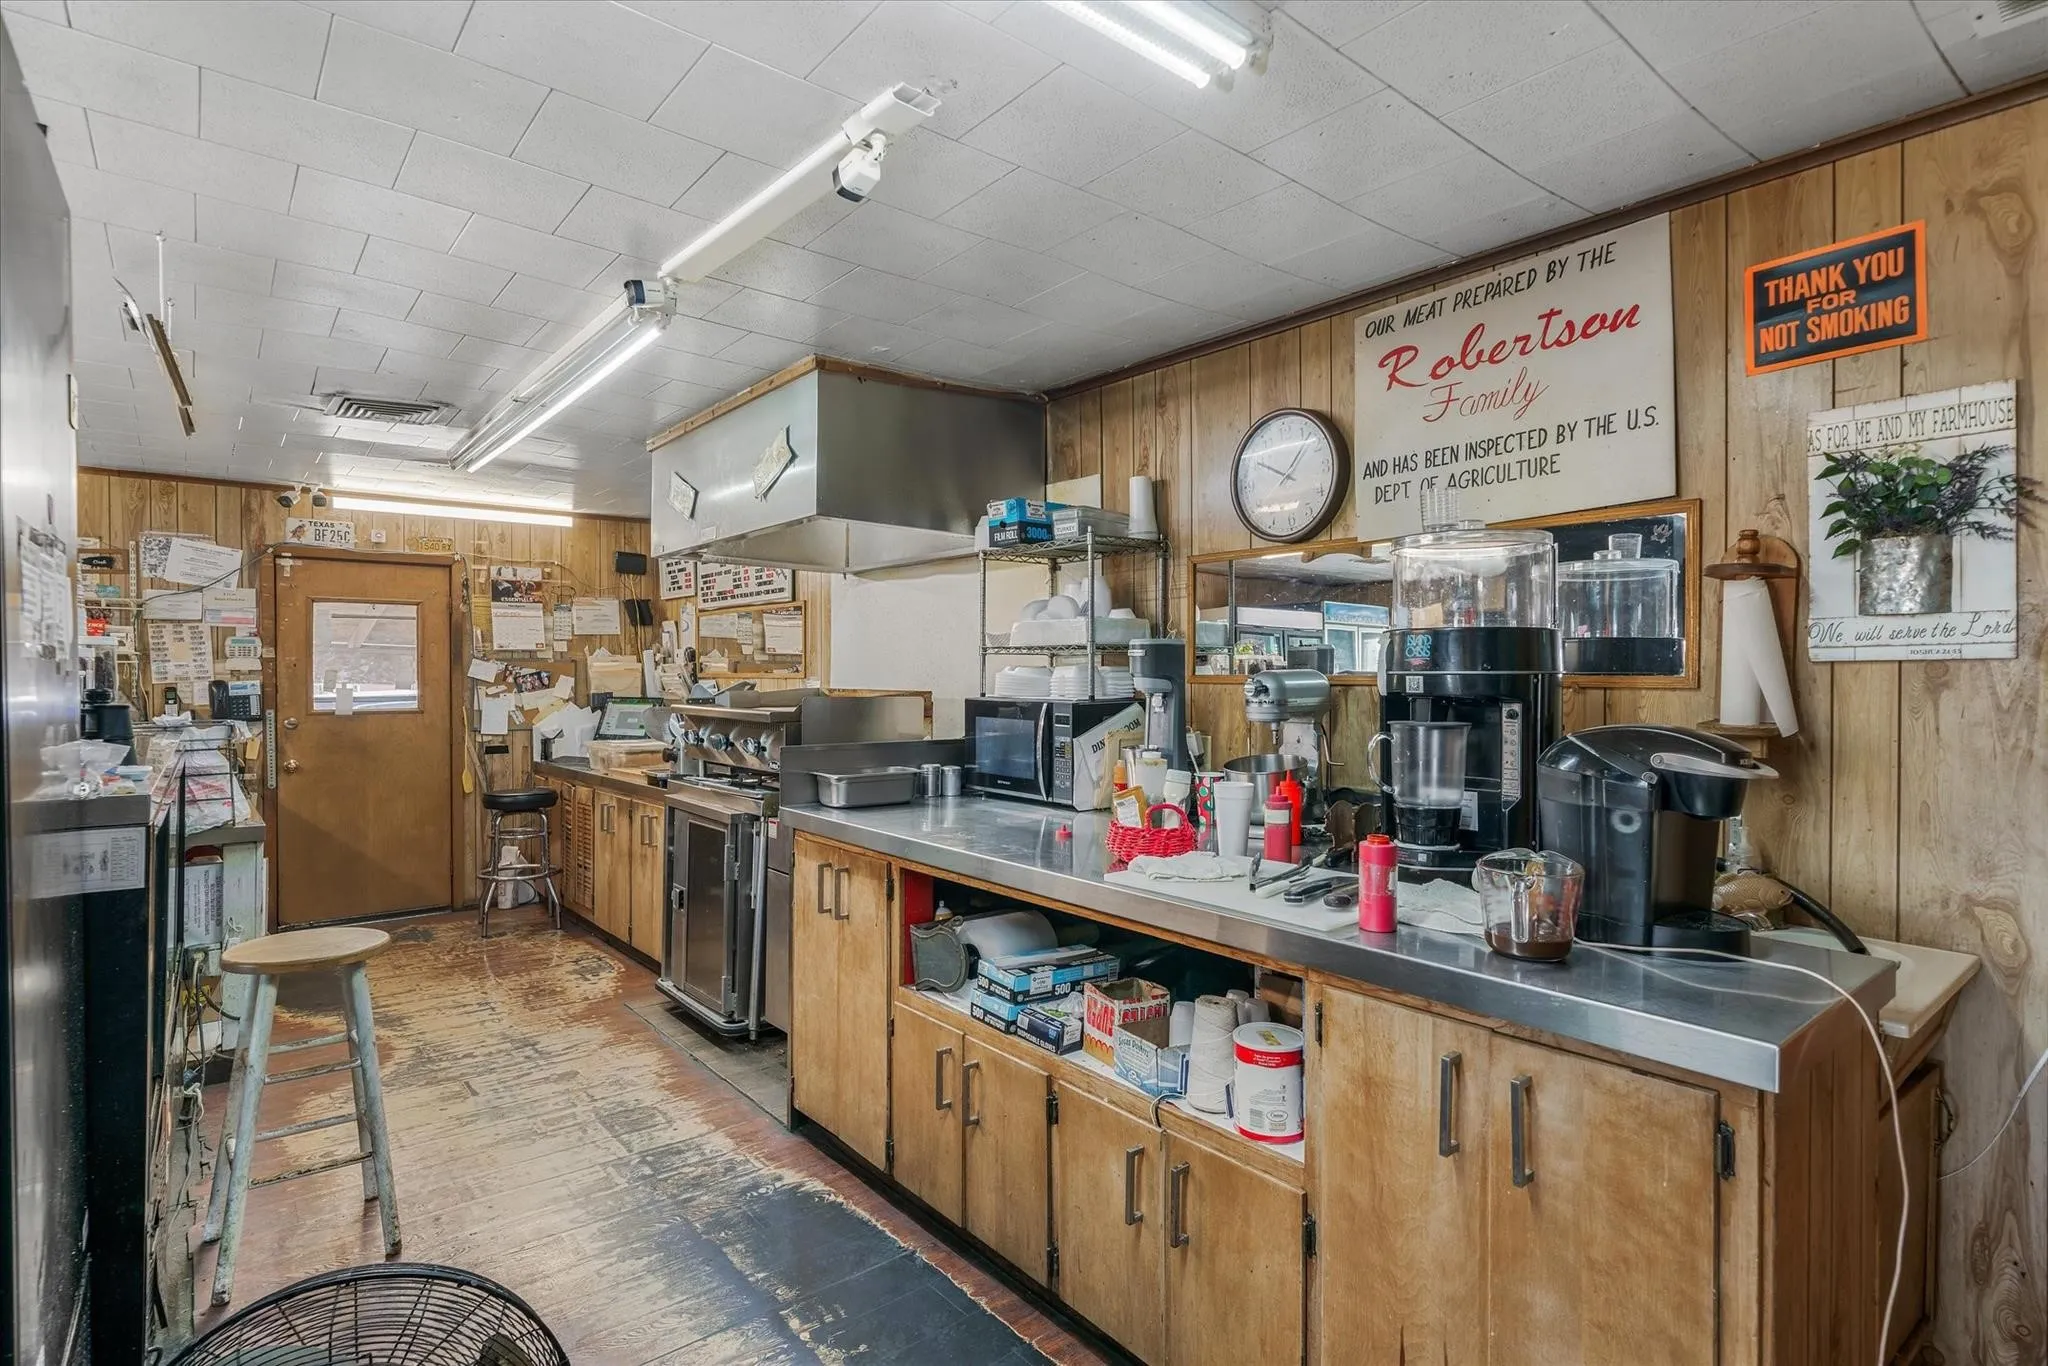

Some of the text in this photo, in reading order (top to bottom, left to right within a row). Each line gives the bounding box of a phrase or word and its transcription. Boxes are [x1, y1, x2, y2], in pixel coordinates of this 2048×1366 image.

[1365, 241, 1617, 338] OUR MEAT PREPARED BY THE
[1764, 247, 1905, 307] THANK YOU
[1806, 289, 1857, 313] FOR
[1759, 295, 1911, 354] NOT SMOKING
[1378, 303, 1641, 391] Robertson
[1422, 366, 1550, 422] Family
[1808, 398, 2014, 452] AS FOR ME AND MY FARMHOUSE
[1363, 406, 1659, 480] AND HAS BEEN INSPECTED BY THE U.S.
[1447, 454, 1561, 489] AGRICULTURE
[1026, 527, 1047, 539] 3000
[1056, 525, 1076, 534] TURKEY
[1854, 625, 1882, 641] will
[1889, 625, 1927, 640] serve
[1931, 622, 1956, 639] the
[1961, 612, 2016, 638] Lord
[978, 977, 989, 989] 500
[1054, 982, 1071, 996] 500
[972, 1006, 984, 1020] 500
[1016, 1029, 1056, 1052] DISPOSABLE GLOVES
